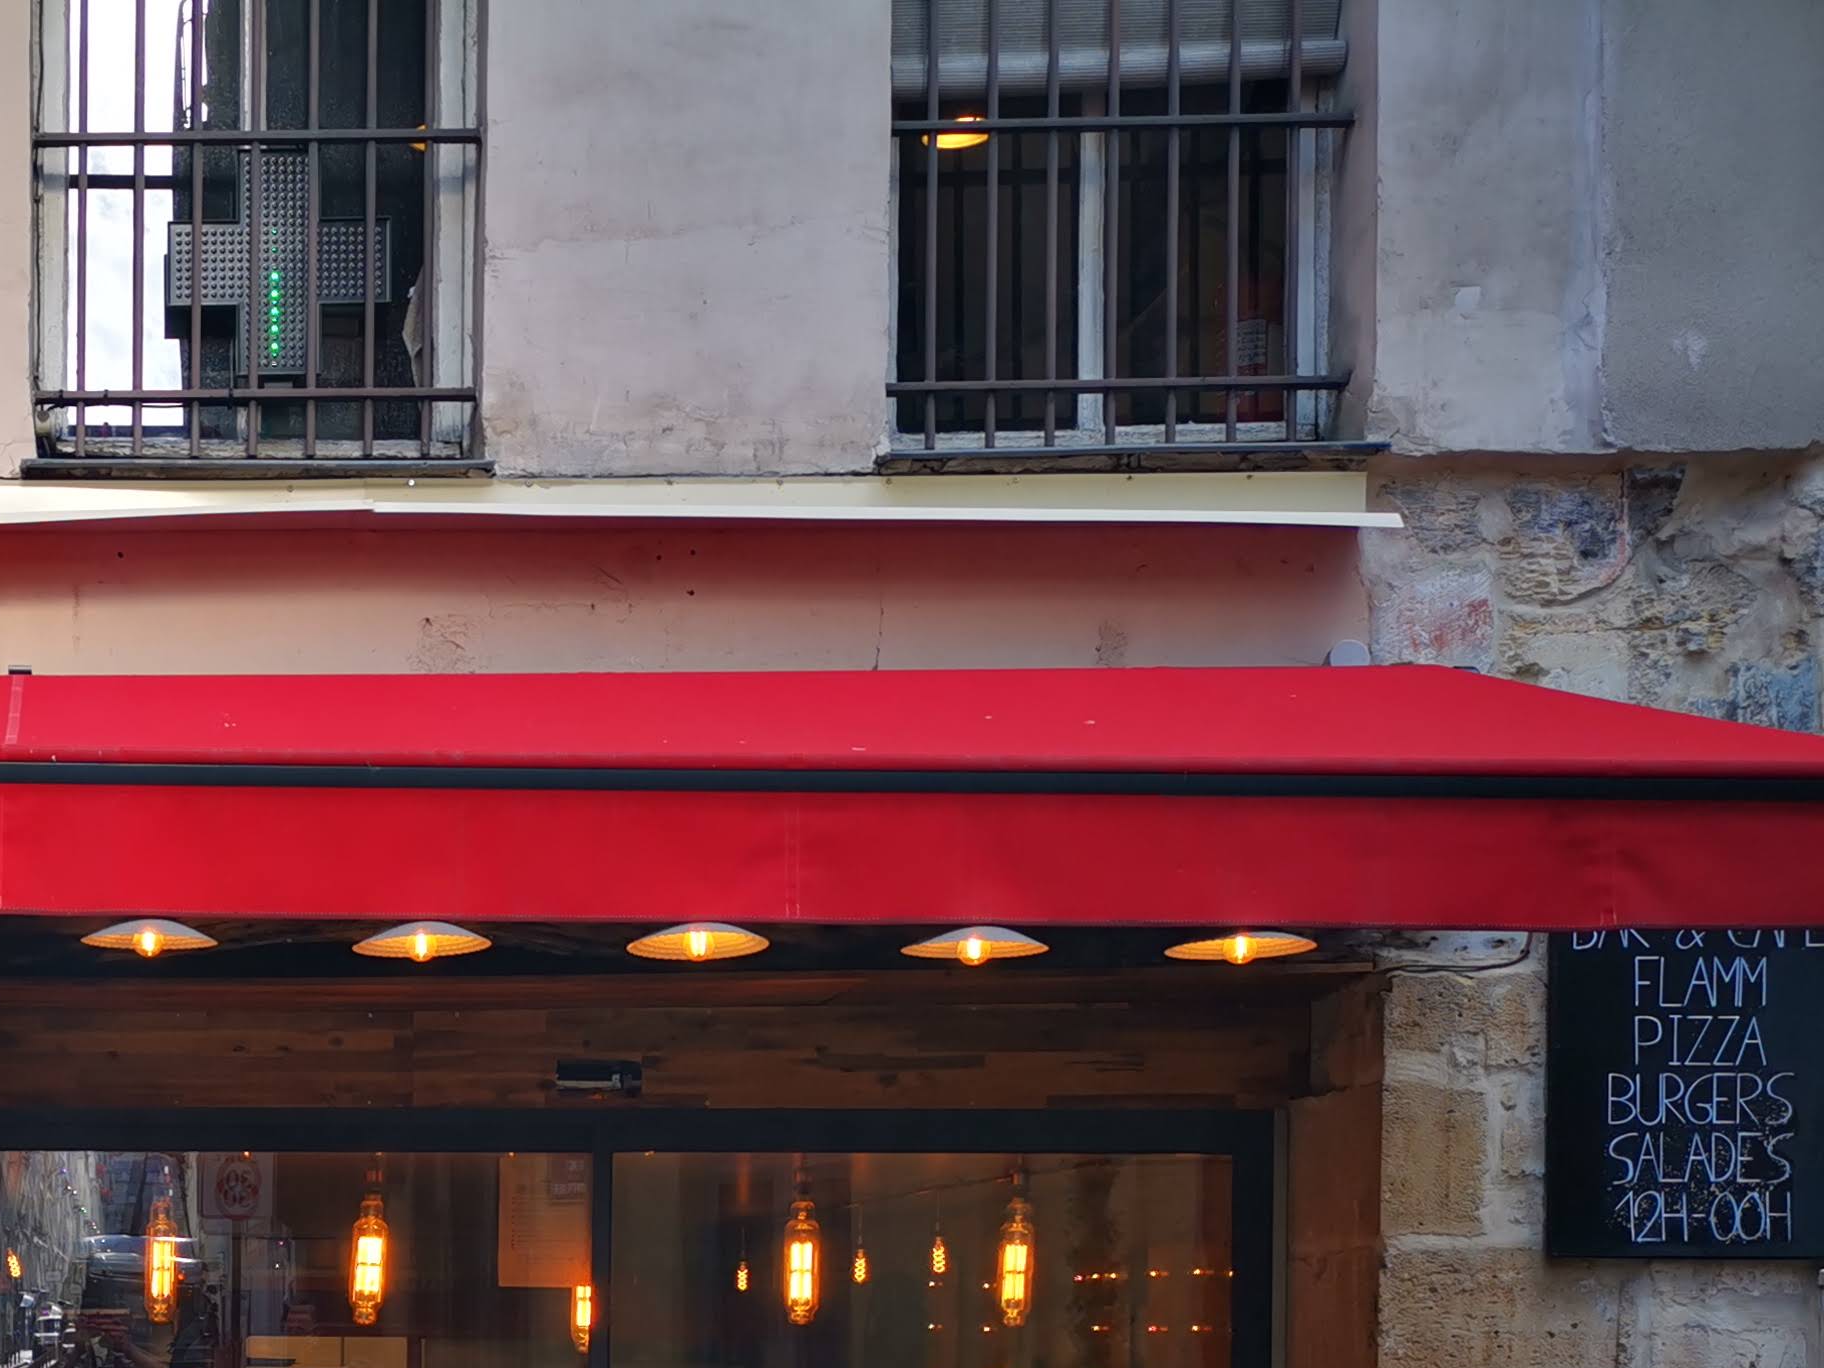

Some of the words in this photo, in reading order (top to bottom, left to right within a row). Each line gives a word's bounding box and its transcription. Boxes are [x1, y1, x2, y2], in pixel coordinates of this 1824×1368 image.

[1634, 955, 1767, 1008] FLAMM
[1634, 1014, 1767, 1066] PIZZA
[1607, 1072, 1794, 1126] BURGERS
[1608, 1131, 1794, 1185] SALADES
[1615, 1187, 1791, 1243] 12H-00H
